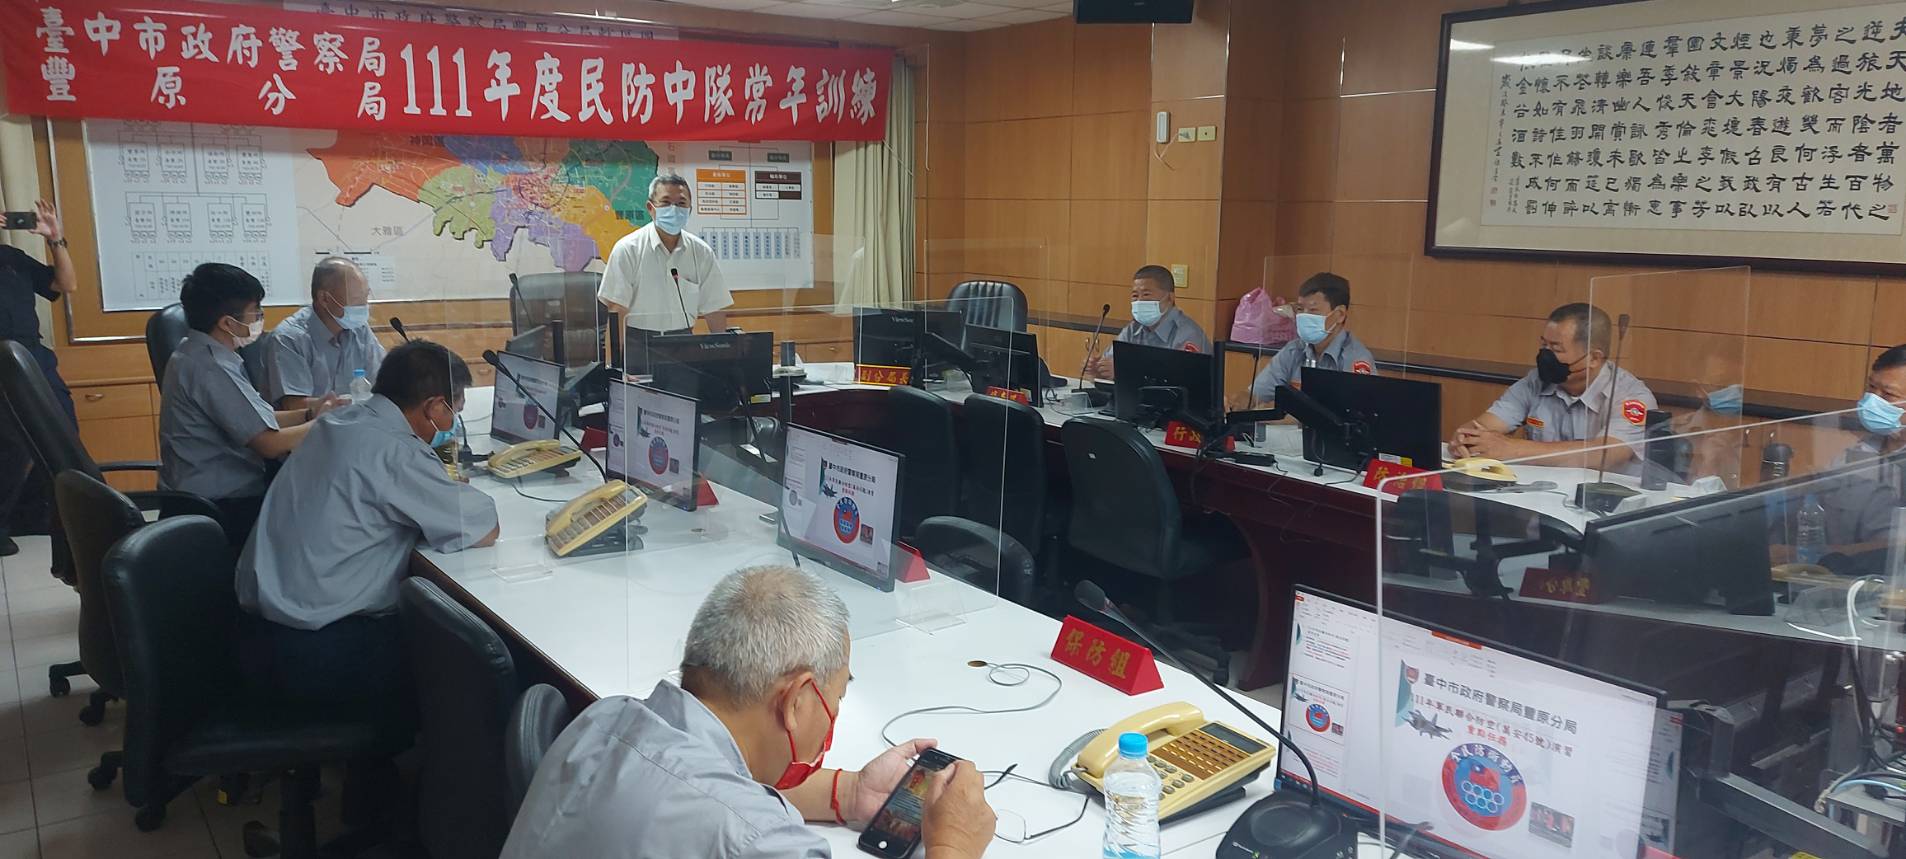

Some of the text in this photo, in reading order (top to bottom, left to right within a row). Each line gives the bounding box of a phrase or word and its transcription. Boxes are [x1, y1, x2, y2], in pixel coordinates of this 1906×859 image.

[36, 6, 387, 78] 臺中市政府警察局
[41, 56, 387, 121] 豐原分局
[400, 42, 877, 125] 111年度民防中隊常年訓練
[1064, 628, 1131, 679] 保防組
[1423, 672, 1578, 735] 臺中市政府警察局豐原分局
